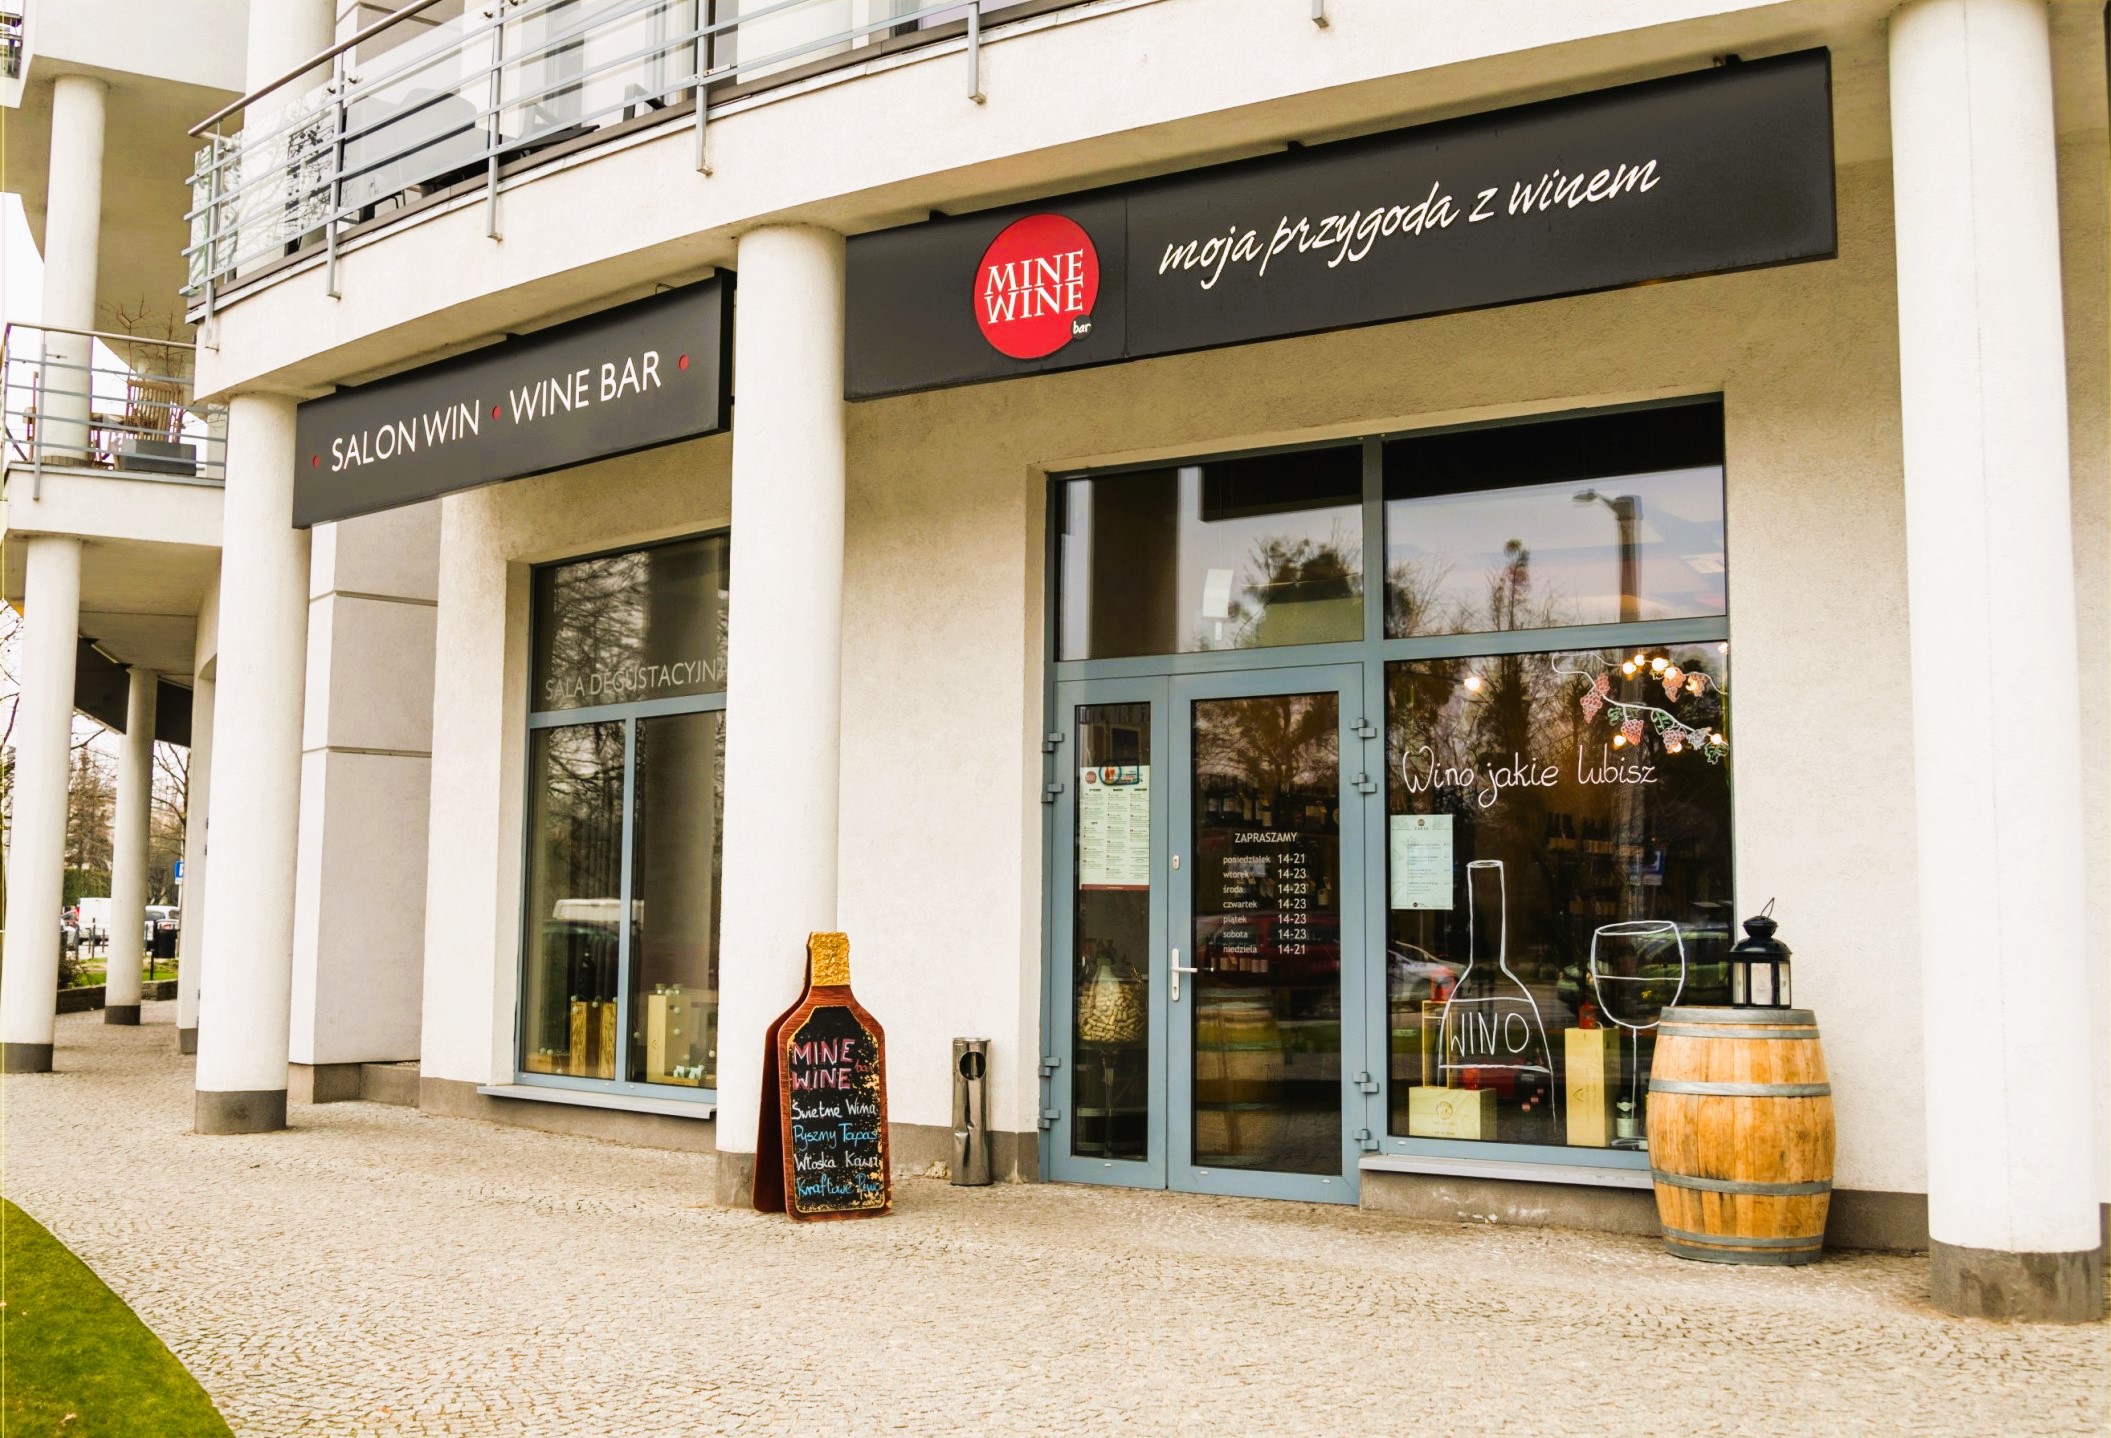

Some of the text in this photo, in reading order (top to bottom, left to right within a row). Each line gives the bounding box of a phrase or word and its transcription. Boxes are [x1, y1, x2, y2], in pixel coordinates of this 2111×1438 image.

[1158, 159, 1660, 290] moja przygoda z winem
[984, 249, 1084, 296] MINE
[984, 278, 1084, 324] WINE
[1072, 320, 1092, 335] bar
[331, 350, 662, 473] SALON WIN WINE BAR
[545, 676, 585, 700] SALA
[1402, 745, 1475, 794] Wino
[1478, 752, 1560, 808] jakie
[1234, 832, 1298, 843] ZAPRASZAMY
[1223, 853, 1305, 865] poniedziałek 14-21
[1223, 868, 1307, 879] wtorek 14-23
[1223, 883, 1307, 894] środa 14-23
[1223, 898, 1307, 909] czwartek 14-23
[1223, 914, 1307, 925] piątek 14-23
[1223, 929, 1307, 939] sobota 14-23
[1223, 944, 1306, 954] niedziela 14-21
[1450, 1012, 1529, 1057] WINO
[792, 1038, 855, 1066] MINE
[792, 1067, 852, 1091] WINE
[838, 1122, 878, 1147] Tapas
